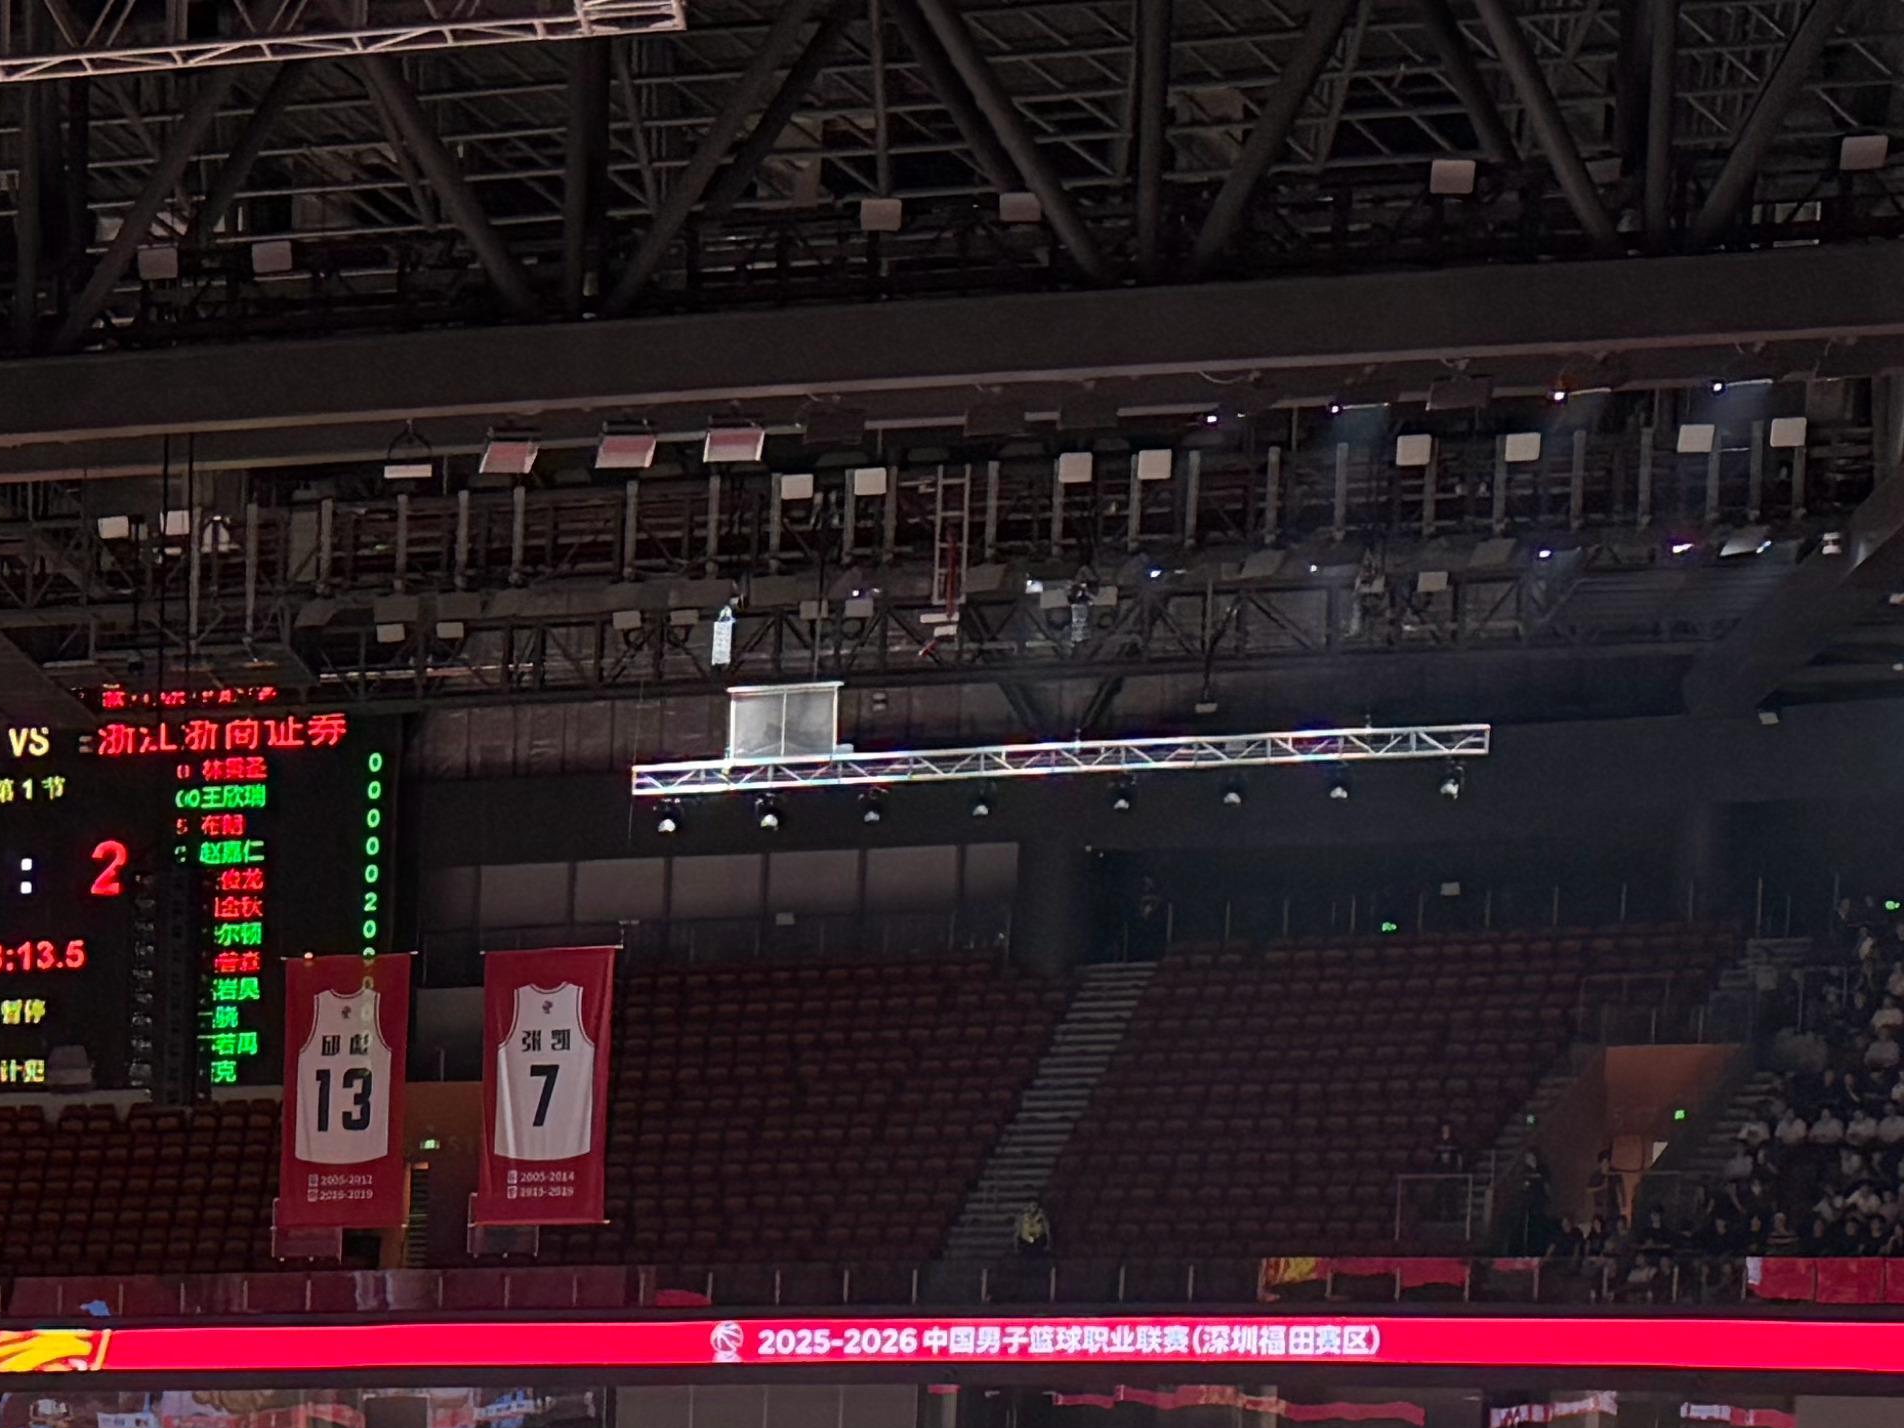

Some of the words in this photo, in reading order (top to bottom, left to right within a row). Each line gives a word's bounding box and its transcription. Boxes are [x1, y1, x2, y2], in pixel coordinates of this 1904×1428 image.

[9, 727, 50, 758] VS
[368, 752, 382, 772] 0
[367, 781, 381, 799] 0
[366, 808, 380, 827] 0
[366, 836, 379, 855] 0
[92, 840, 127, 895] 2
[365, 864, 378, 882] 0
[364, 892, 377, 911] 2
[363, 919, 376, 938] 0
[316, 1068, 373, 1132] 13
[530, 1064, 560, 1127] 7
[758, 1328, 917, 1354] 2025-2026
[923, 1325, 1379, 1355] 中国男子篮球职业联赛(深圳福田赛区)
